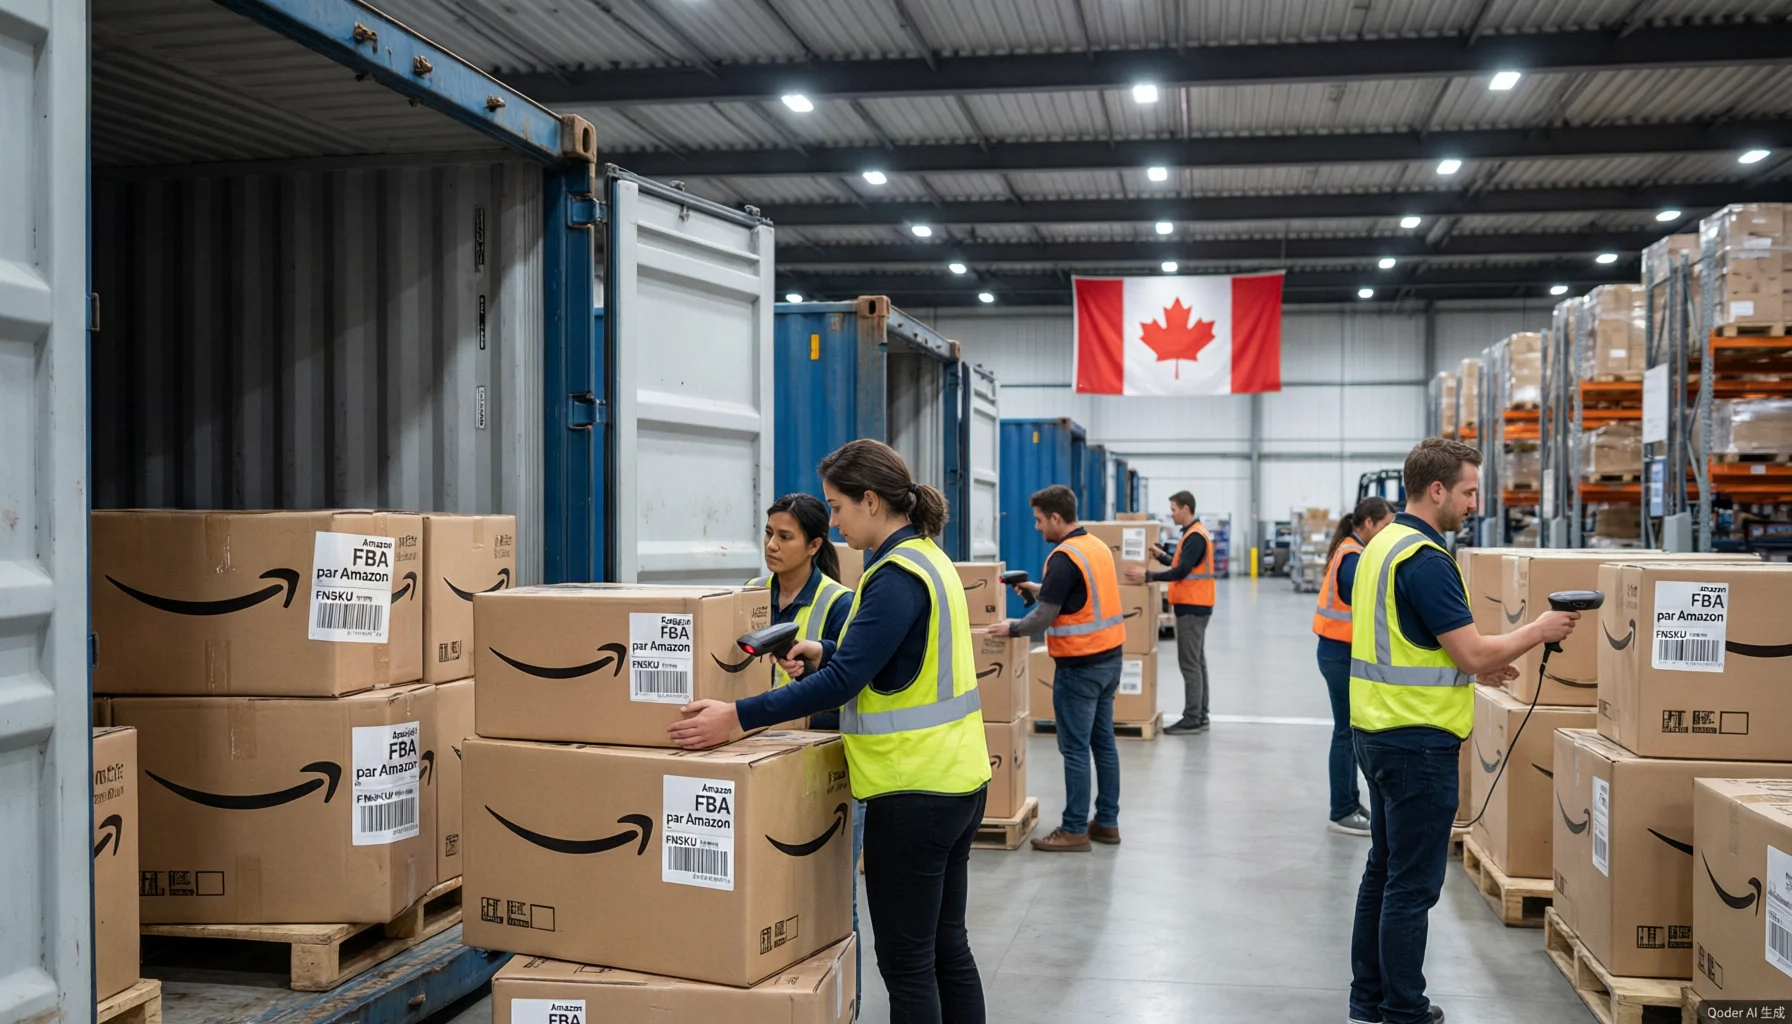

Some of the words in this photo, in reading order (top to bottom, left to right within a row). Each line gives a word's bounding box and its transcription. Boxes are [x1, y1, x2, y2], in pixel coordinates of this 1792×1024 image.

[353, 548, 388, 567] FBA
[317, 568, 338, 580] par
[340, 568, 388, 581] Amazon
[316, 591, 353, 601] FNSKU
[1691, 593, 1724, 608] FBA
[1657, 612, 1676, 622] par
[1677, 610, 1724, 622] Amazon
[661, 626, 689, 640] FBA
[1656, 630, 1687, 639] FNSKU
[632, 642, 648, 653] par
[650, 641, 690, 652] Amazon
[632, 660, 659, 669] FNSKU
[389, 739, 417, 760] FBA
[356, 767, 377, 780] par
[695, 795, 731, 815] FBA
[667, 814, 684, 825] par
[686, 813, 730, 829] Amazon
[666, 835, 697, 847] FNSKU
[549, 1013, 581, 1024] FBA
